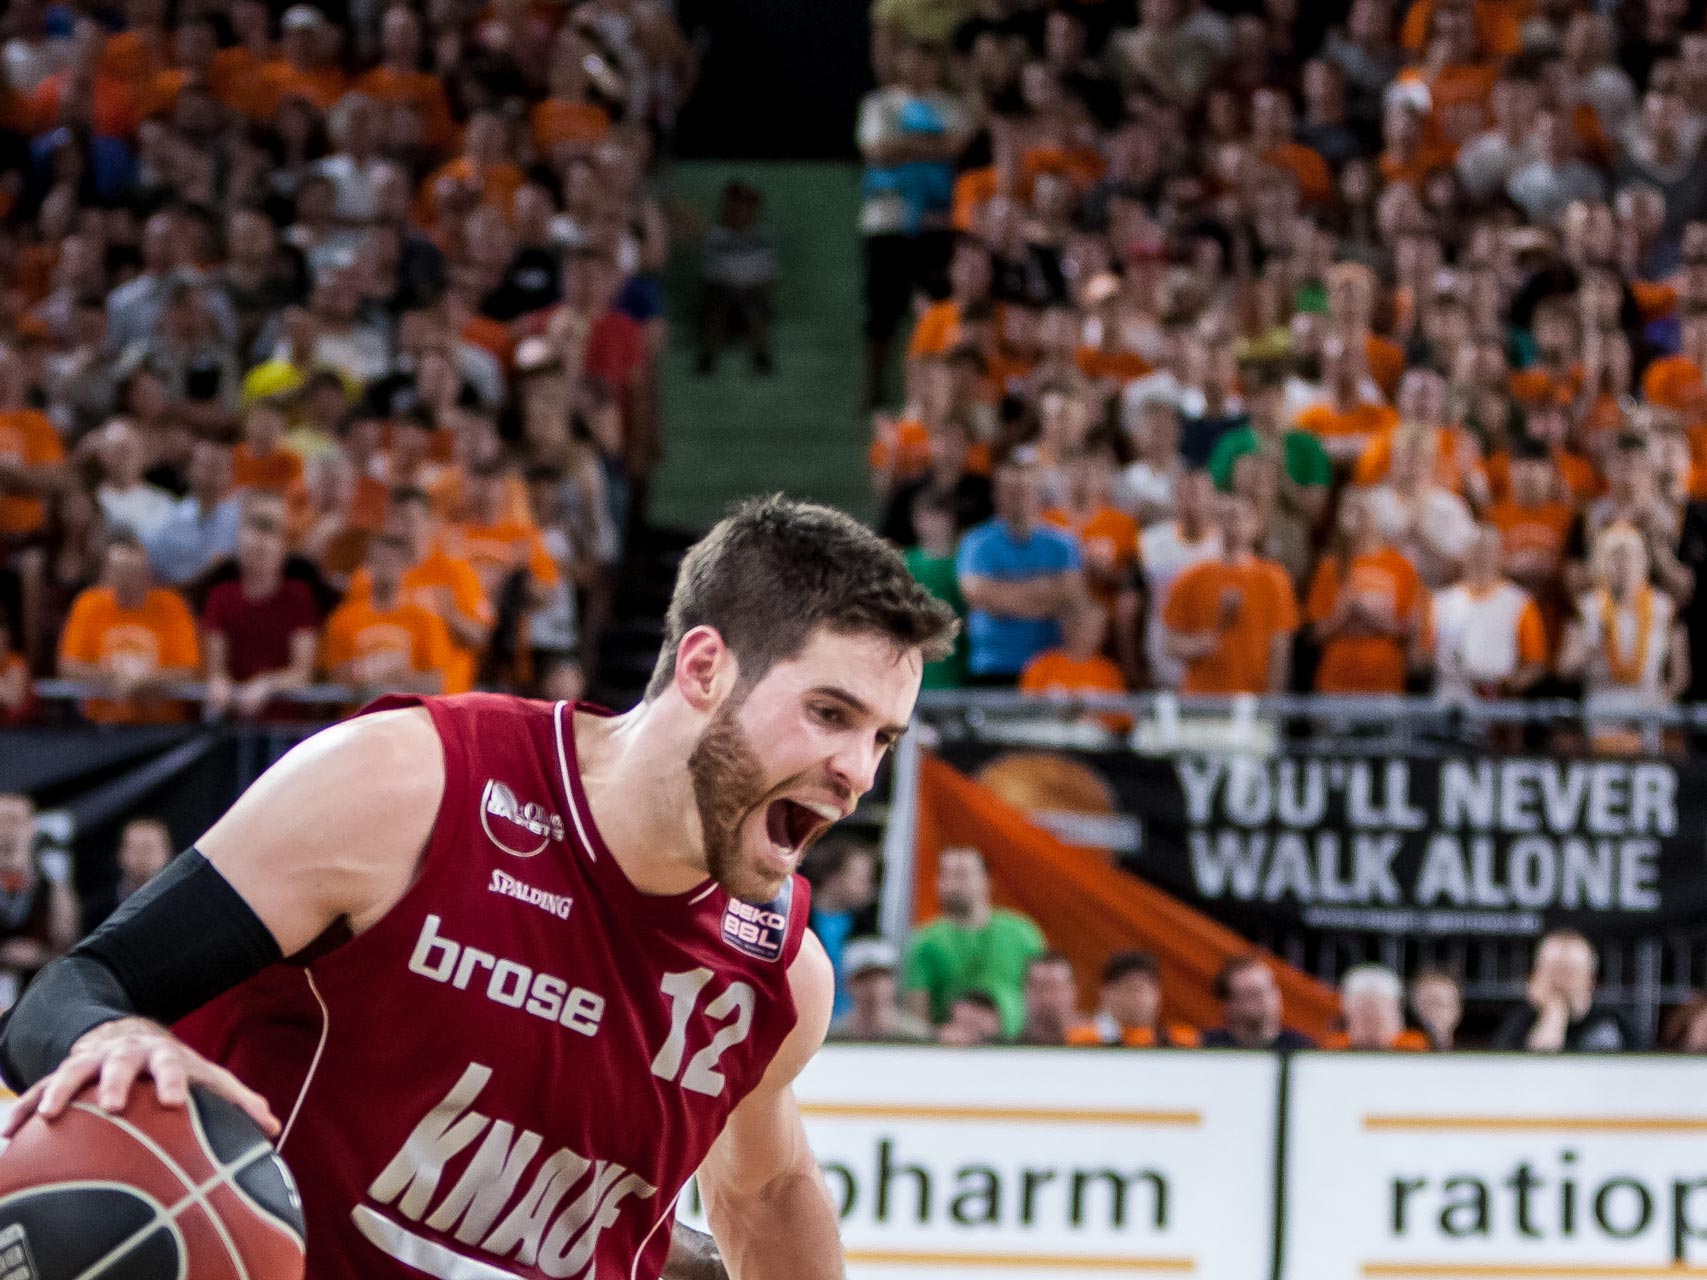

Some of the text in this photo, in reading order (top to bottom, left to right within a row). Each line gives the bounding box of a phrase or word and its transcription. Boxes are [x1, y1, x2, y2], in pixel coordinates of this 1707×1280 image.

[1174, 756, 1427, 830] YOU'LL
[1438, 758, 1680, 837] NEVER
[488, 868, 574, 920] SPALDING
[1188, 829, 1402, 902] WALK
[1415, 834, 1661, 910] ALONE
[724, 913, 779, 950] BBL
[727, 897, 786, 931] BEKO
[408, 914, 606, 1037] brose
[650, 966, 755, 1098] 12
